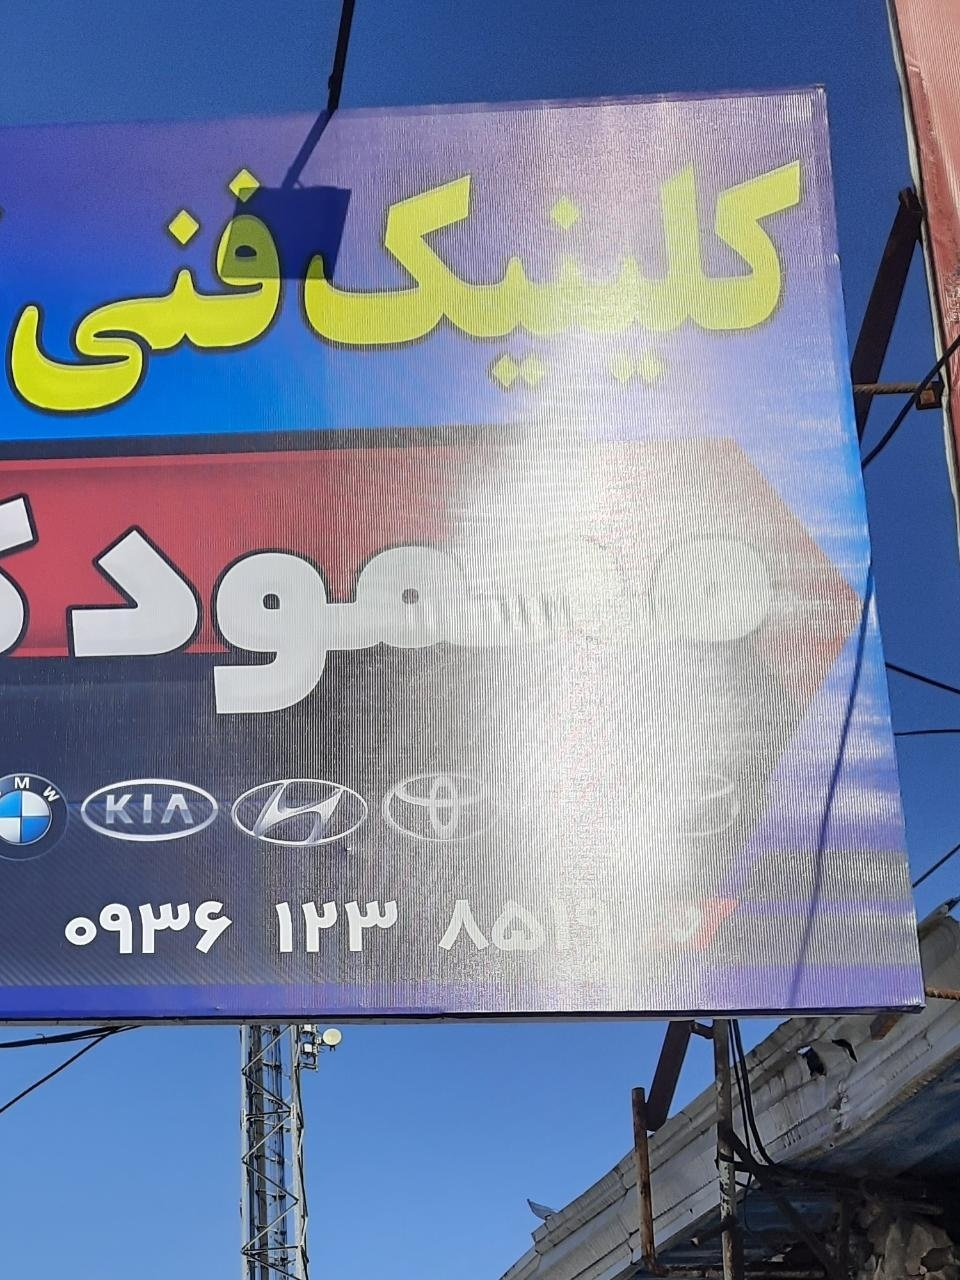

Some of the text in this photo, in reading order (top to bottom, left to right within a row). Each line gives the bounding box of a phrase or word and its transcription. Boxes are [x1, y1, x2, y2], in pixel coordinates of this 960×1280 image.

[11, 170, 281, 412] فنی
[304, 160, 801, 388] کلینیک
[105, 793, 194, 824] KIA
[64, 900, 233, 953] ۰۹۳۶
[275, 900, 398, 953] ۱۲۳
